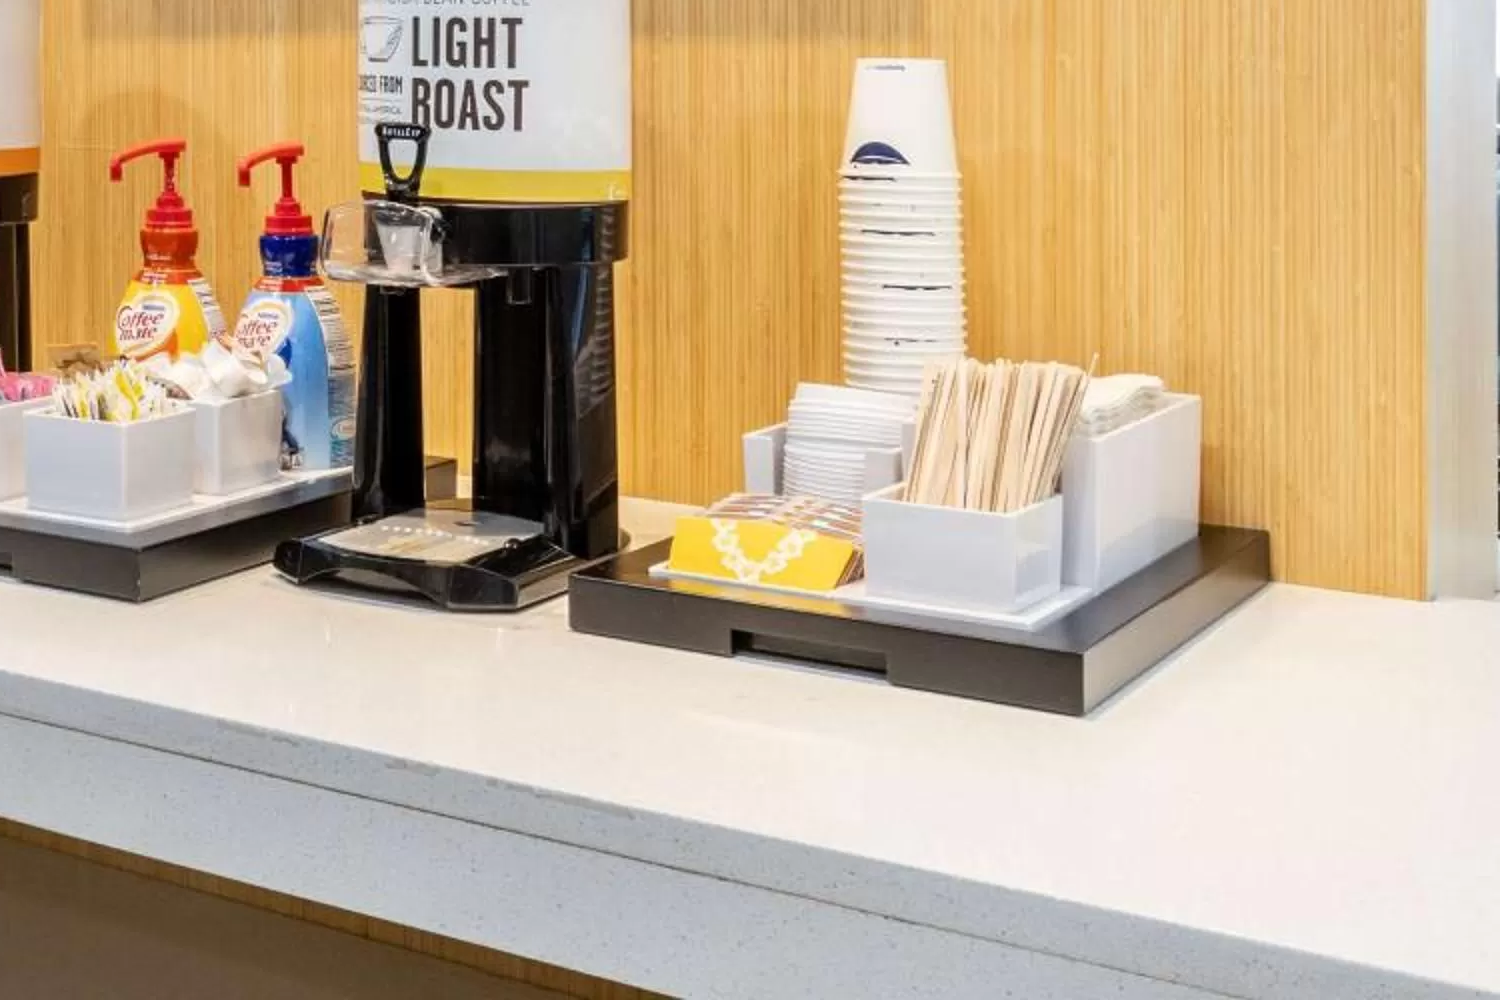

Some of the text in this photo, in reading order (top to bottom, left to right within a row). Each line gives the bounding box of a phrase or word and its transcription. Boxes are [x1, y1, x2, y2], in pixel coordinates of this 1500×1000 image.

[412, 16, 523, 69] LIGHT
[379, 75, 403, 95] FROM
[412, 77, 530, 132] ROAST
